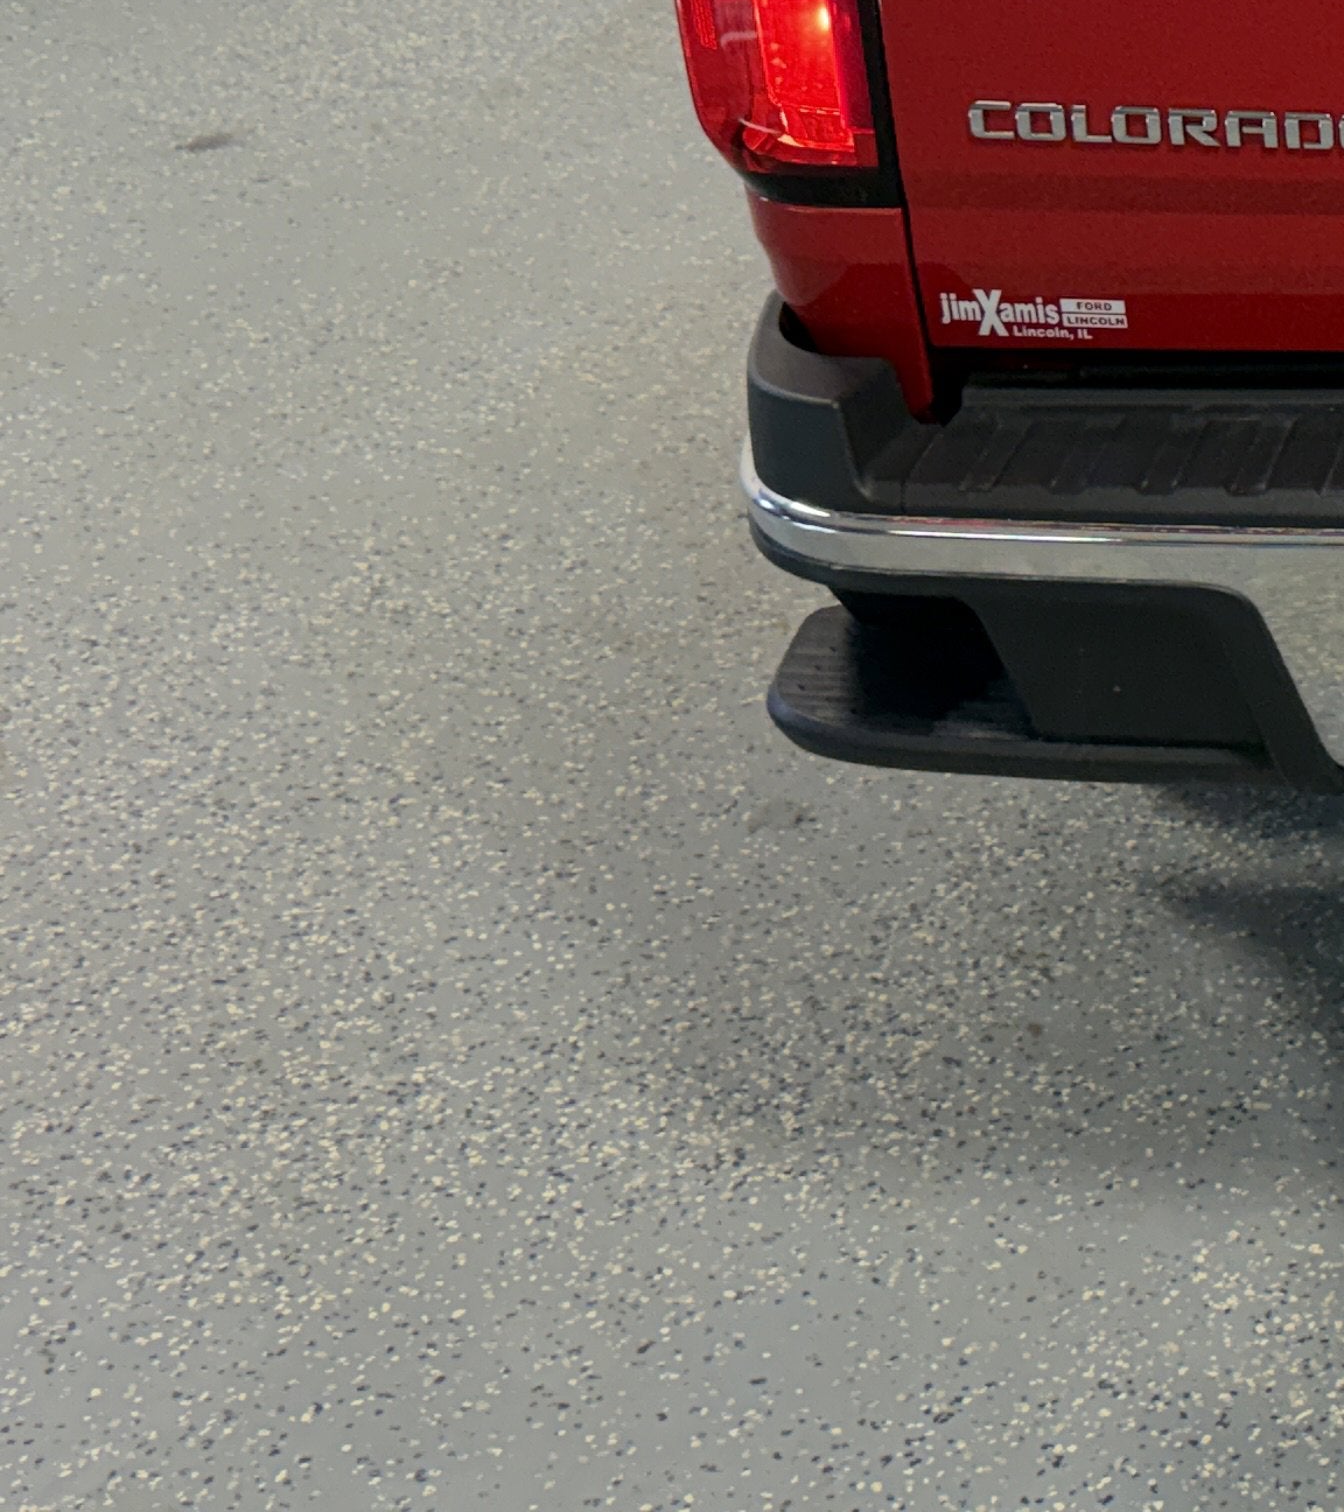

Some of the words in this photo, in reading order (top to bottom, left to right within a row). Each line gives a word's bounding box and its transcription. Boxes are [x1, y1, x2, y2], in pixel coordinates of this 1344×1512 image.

[1076, 301, 1113, 311] FORD
[1066, 315, 1126, 327] LINCOLN
[1012, 325, 1075, 341] Lincoln,
[1077, 328, 1094, 340] IL
